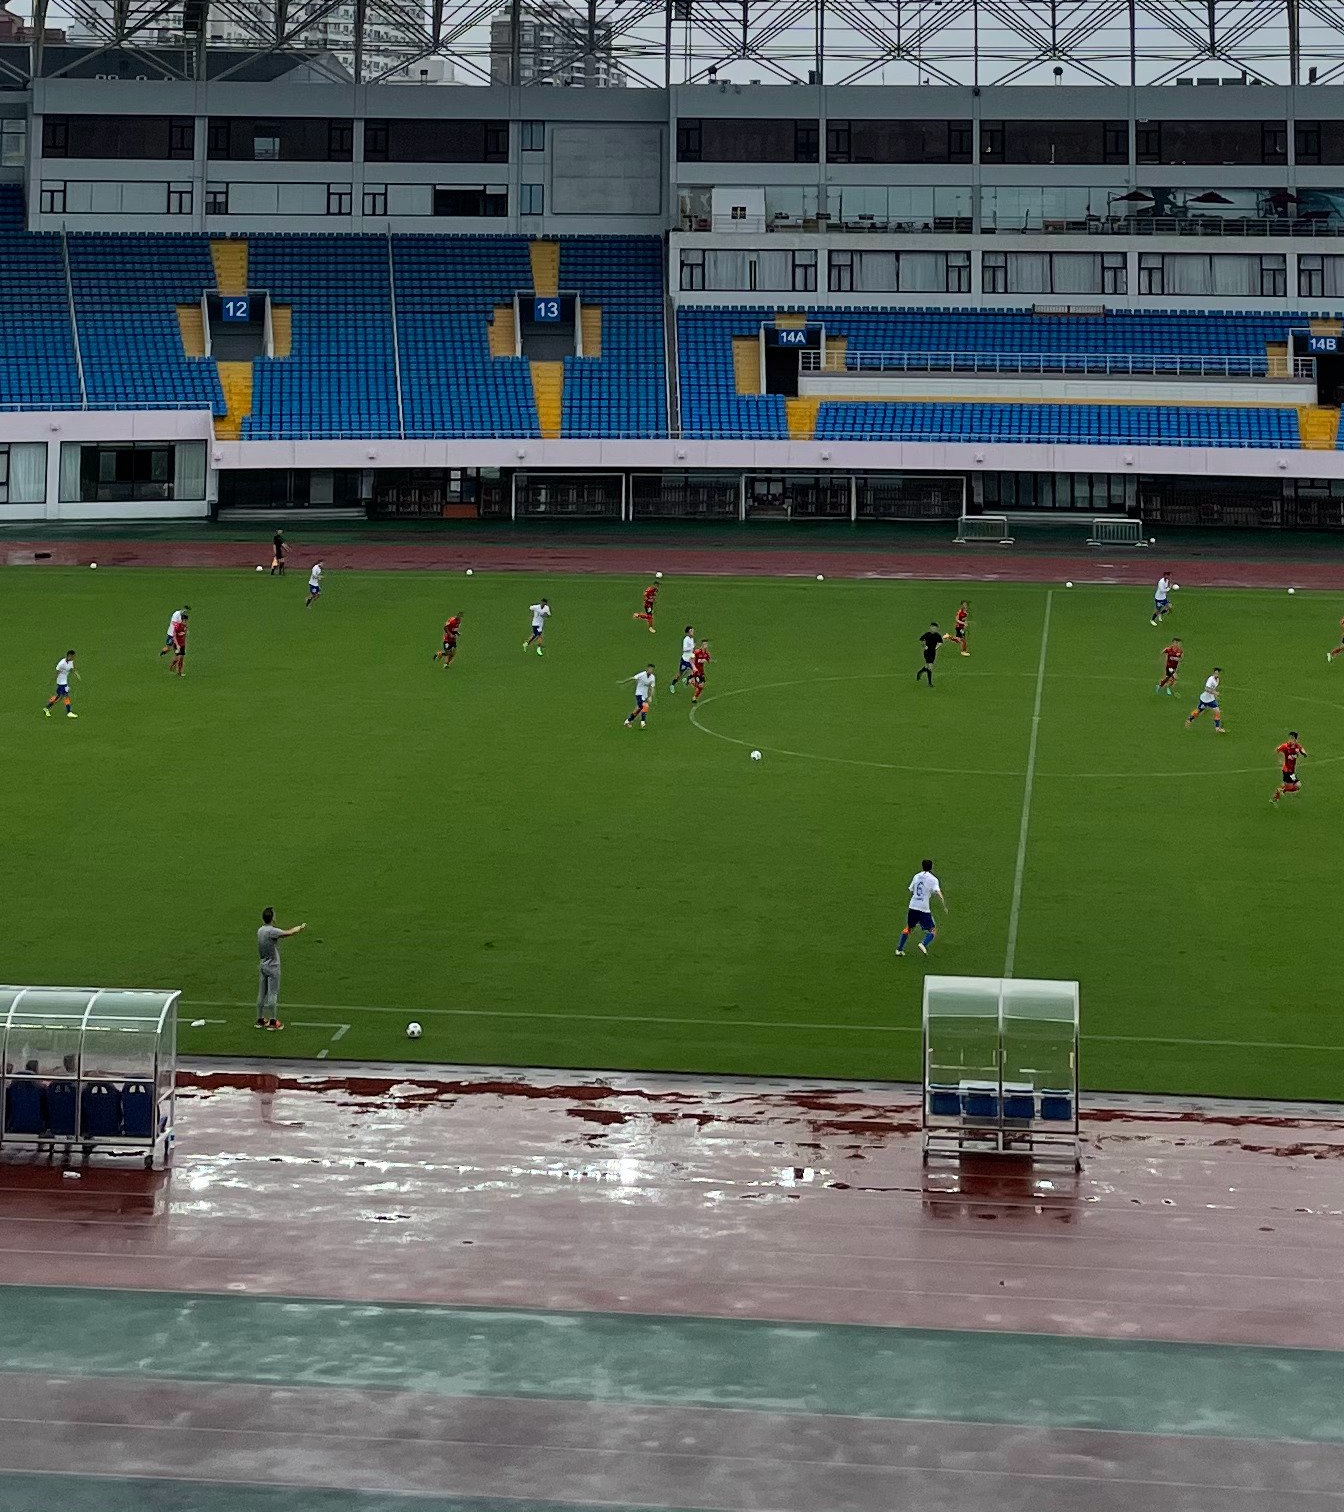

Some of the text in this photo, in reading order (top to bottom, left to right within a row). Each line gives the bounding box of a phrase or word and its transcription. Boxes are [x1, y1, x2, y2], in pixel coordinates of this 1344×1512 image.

[225, 301, 247, 317] 12
[537, 302, 558, 317] 13
[781, 331, 806, 343] 14A
[1310, 338, 1336, 350] 14B
